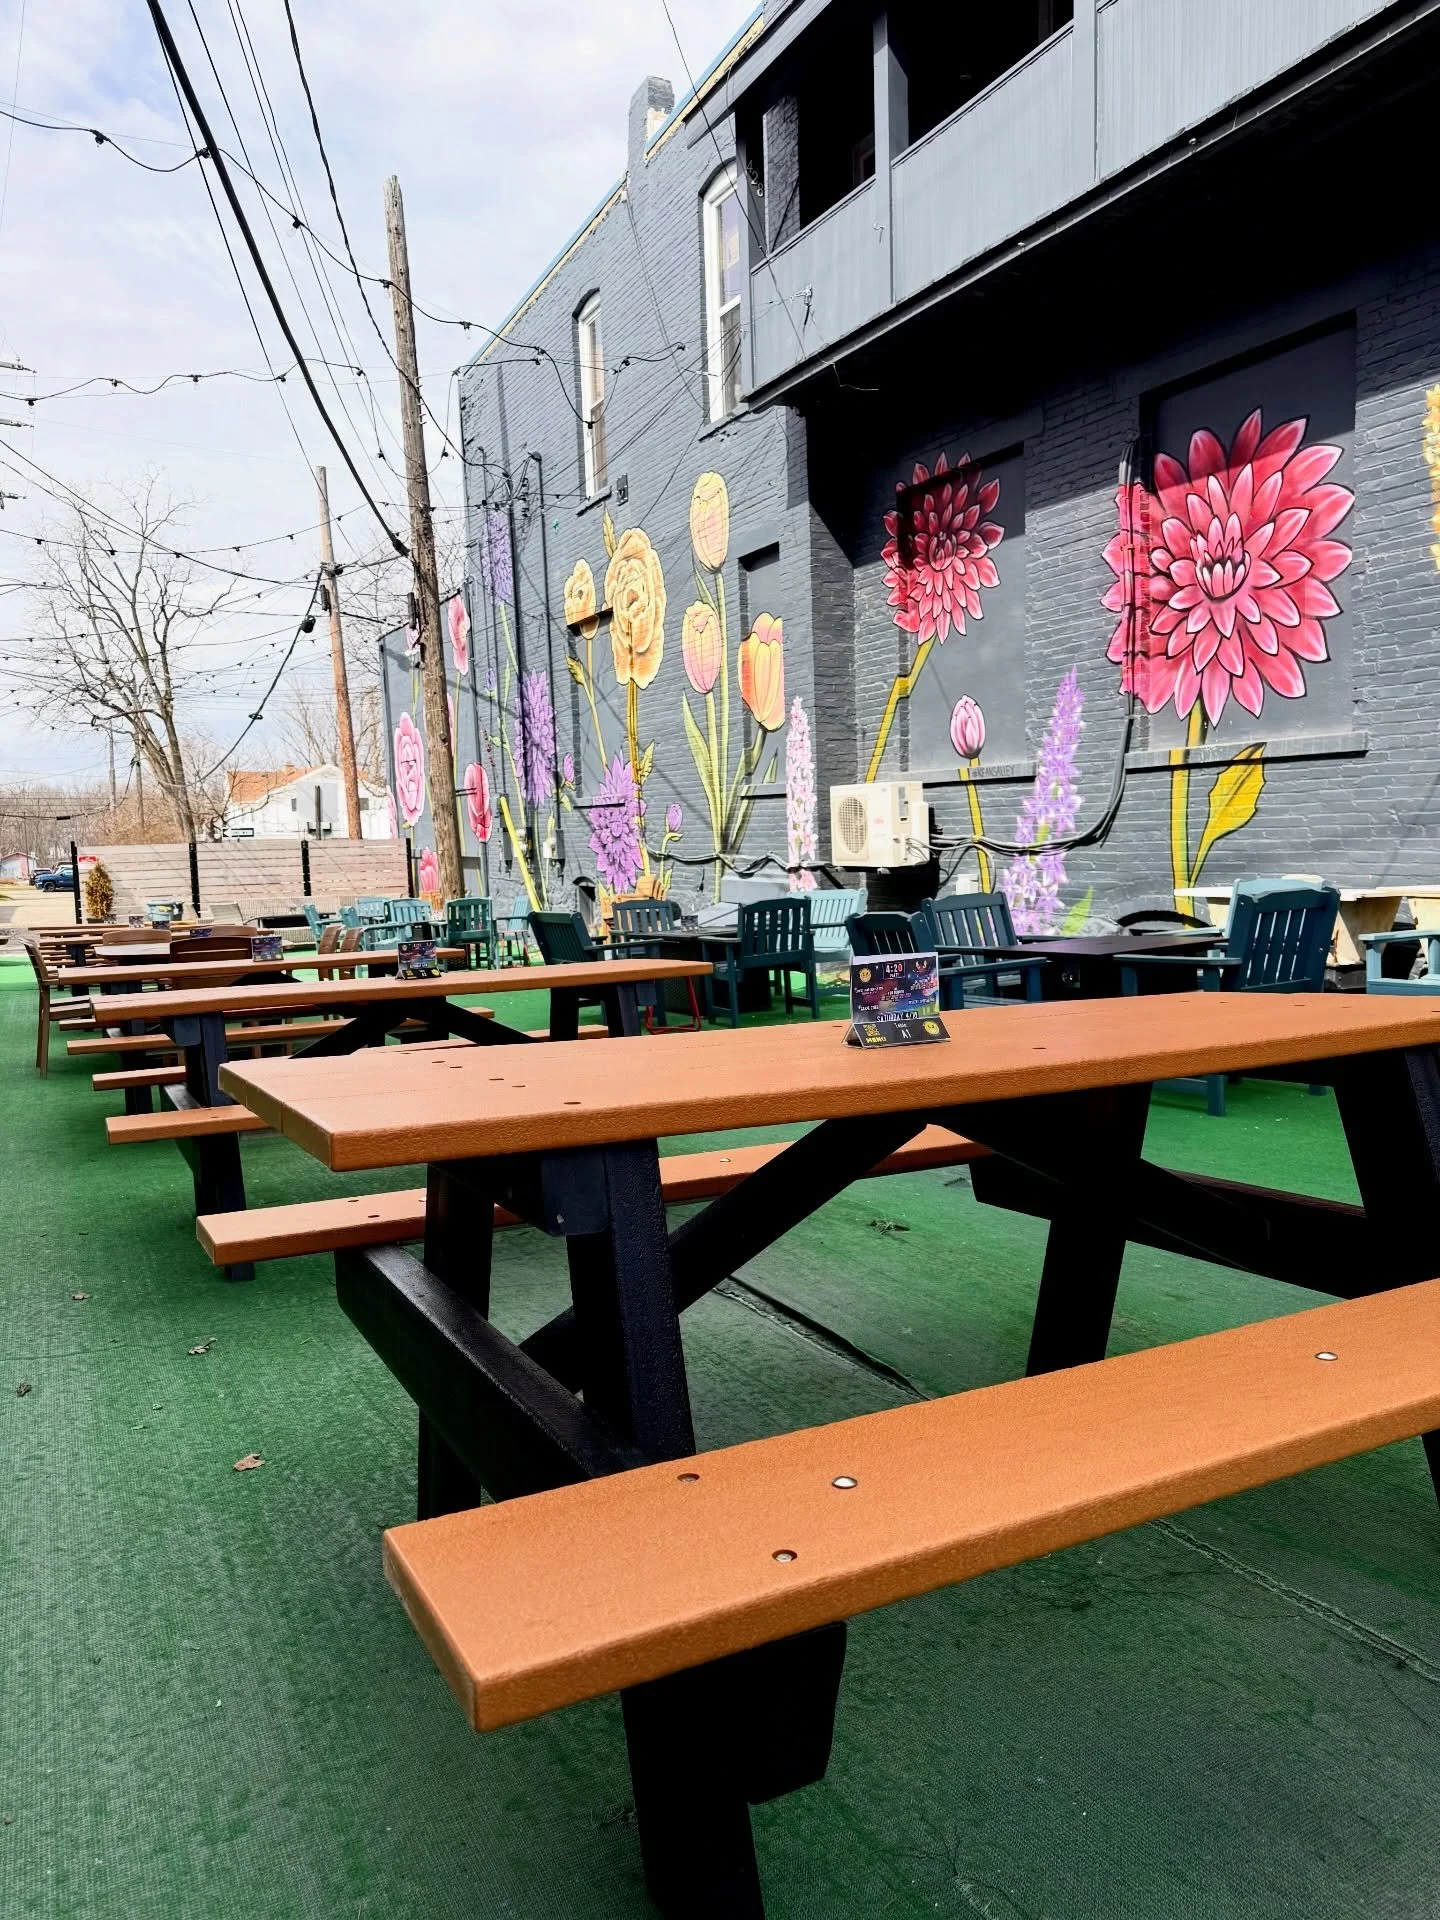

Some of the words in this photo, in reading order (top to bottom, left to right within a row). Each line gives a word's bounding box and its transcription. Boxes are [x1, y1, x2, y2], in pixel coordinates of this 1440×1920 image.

[747, 159, 764, 197] 428
[886, 963, 903, 973] 4:20
[877, 1012, 903, 1022] SATURDAY
[901, 1029, 911, 1039] A1
